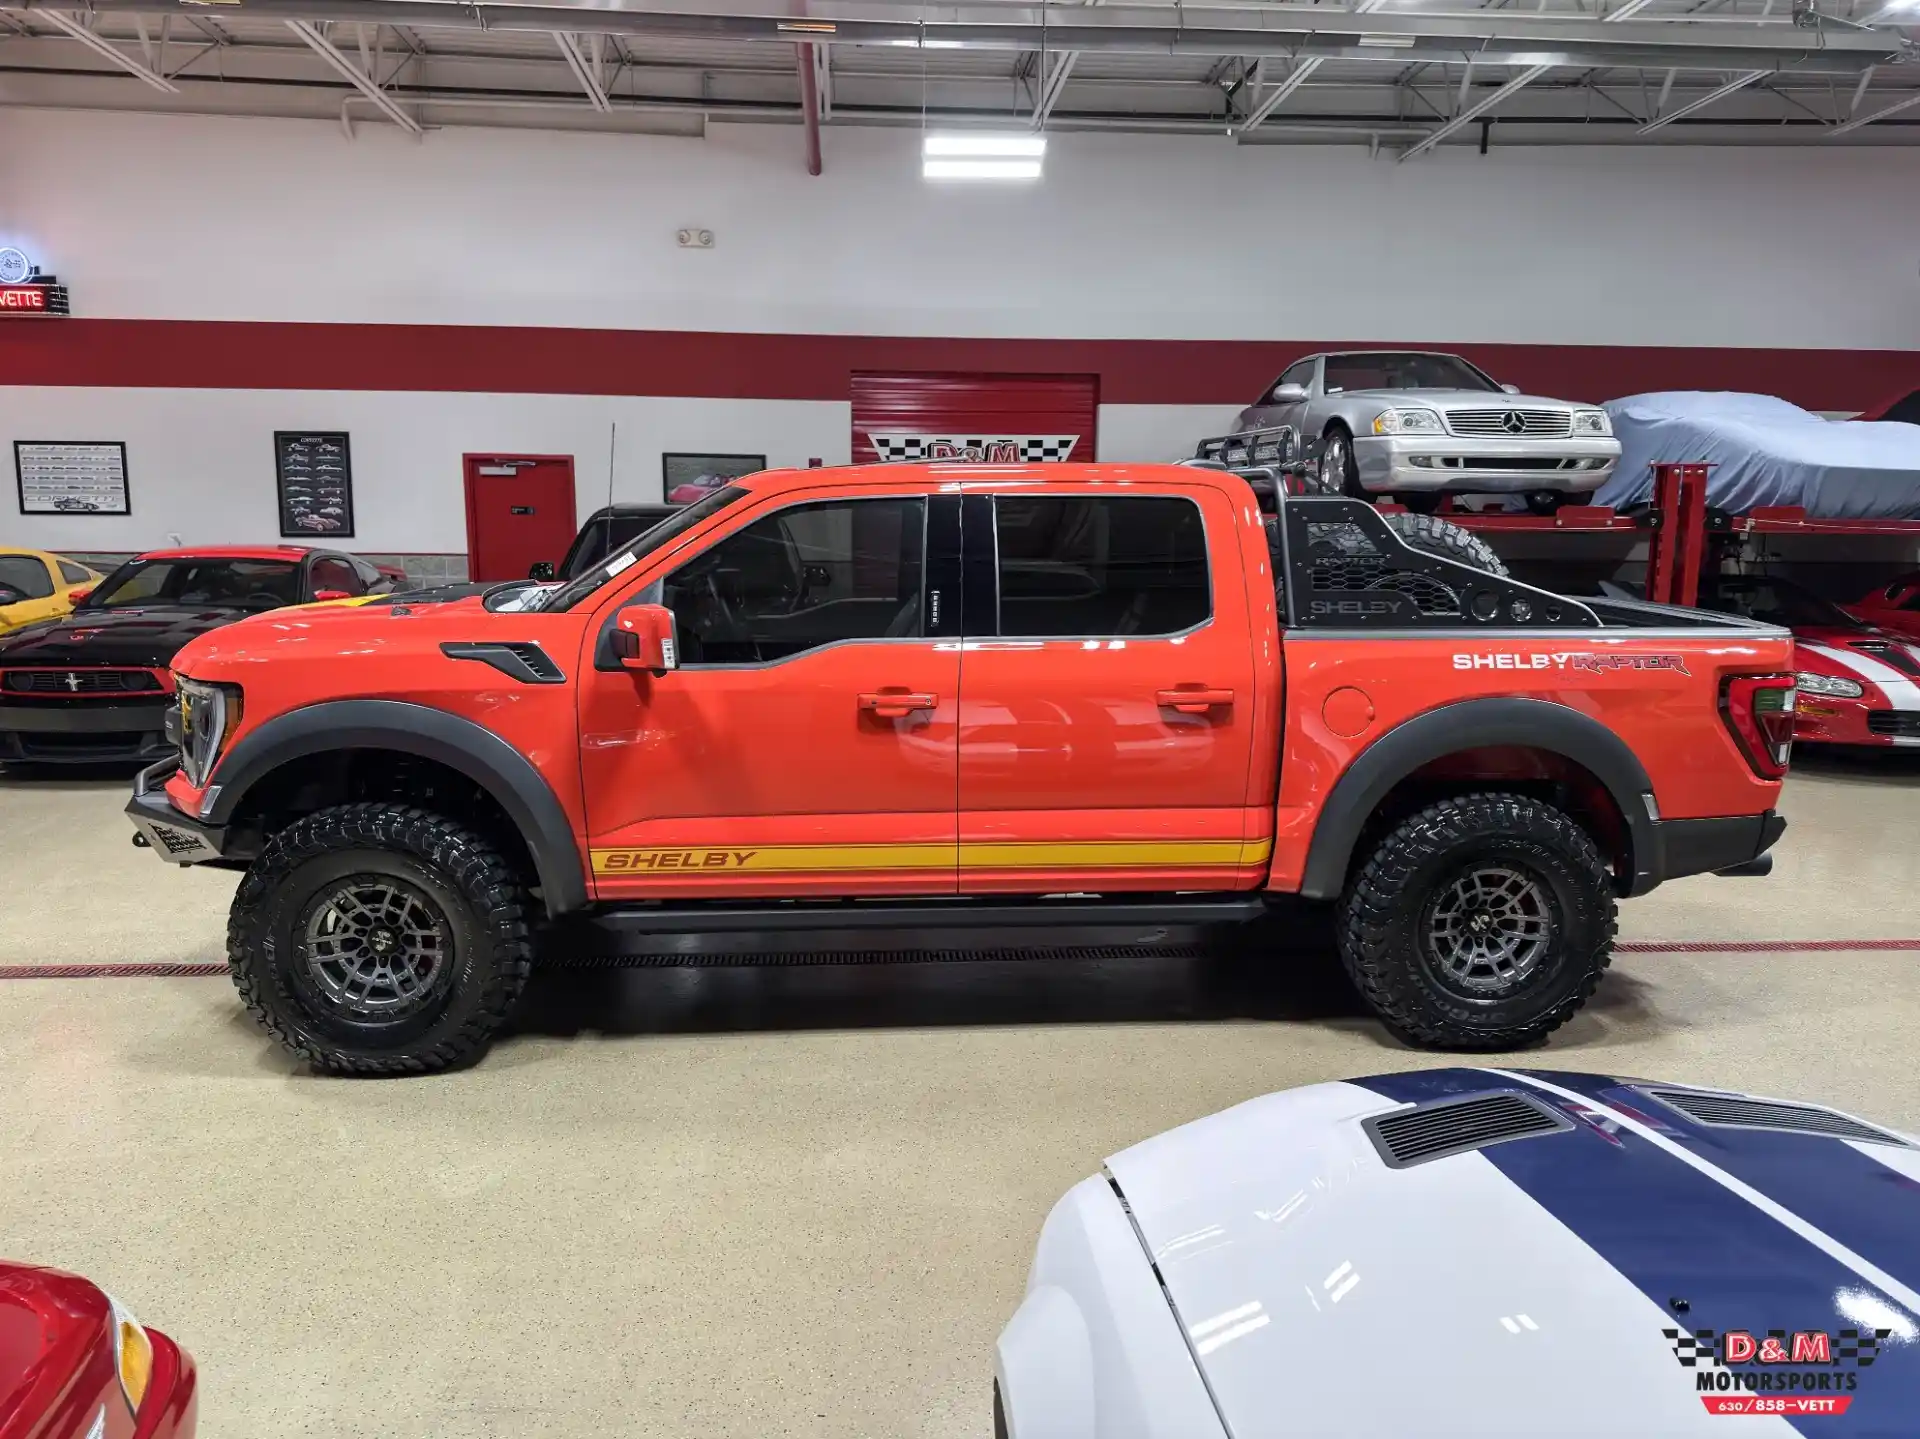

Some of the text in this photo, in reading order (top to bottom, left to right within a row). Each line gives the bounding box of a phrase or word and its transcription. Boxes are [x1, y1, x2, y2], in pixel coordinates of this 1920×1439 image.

[1310, 601, 1401, 614] SHELBY
[1453, 652, 1692, 677] SHELBY RAPTOR
[604, 851, 758, 869] SHELBY
